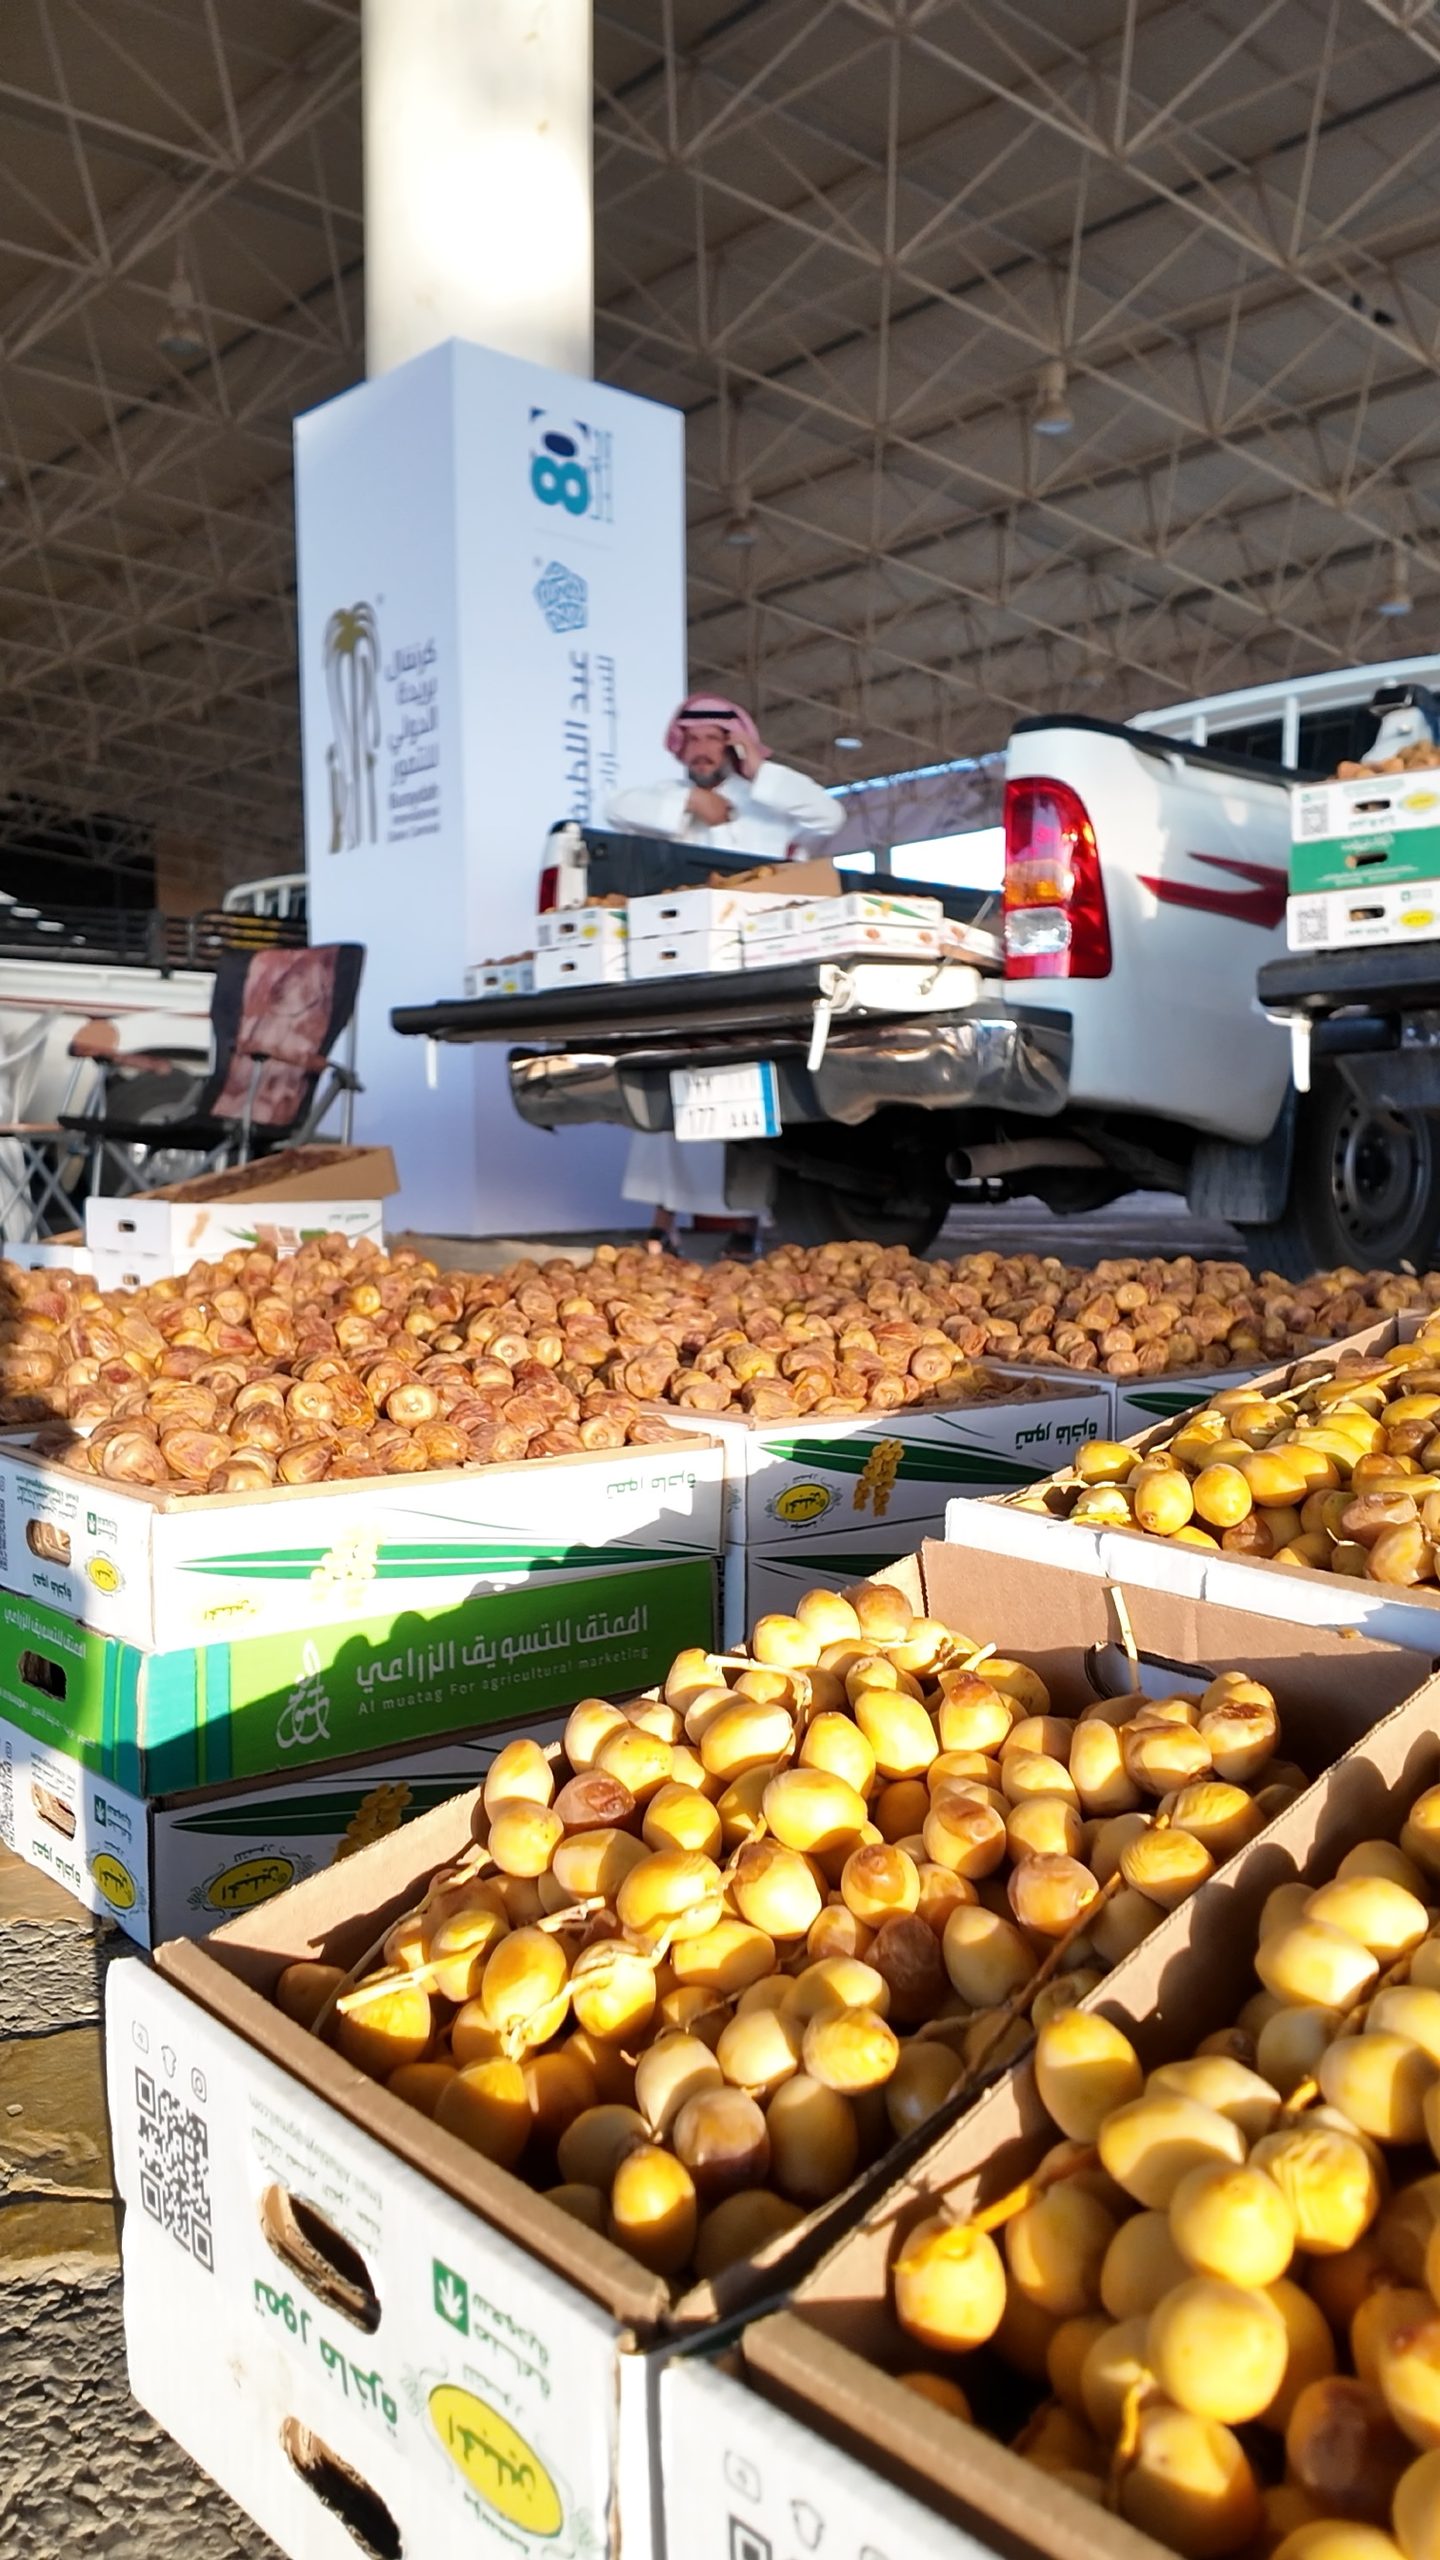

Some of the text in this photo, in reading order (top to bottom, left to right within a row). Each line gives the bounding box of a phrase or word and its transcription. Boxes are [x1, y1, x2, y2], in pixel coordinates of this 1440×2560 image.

[384, 637, 436, 682] كرنفال
[396, 676, 437, 706] بريدة
[387, 706, 437, 755] الدولي
[391, 744, 439, 786] للتمور
[1016, 1417, 1098, 1450] تمور فاخرة
[461, 1618, 571, 1670] للتسويق
[576, 1604, 649, 1646] المعتق
[356, 1641, 456, 1693] الزراعي
[358, 1699, 375, 1716] Al
[449, 1681, 476, 1697] For
[482, 1660, 573, 1691] agricultural
[578, 1646, 649, 1670] marketing
[32, 1840, 81, 1888] تمور فاخرة
[473, 2293, 549, 2369] سعودية
[254, 2278, 398, 2438] تمور فاخرة
[474, 2322, 550, 2401] صناعة
